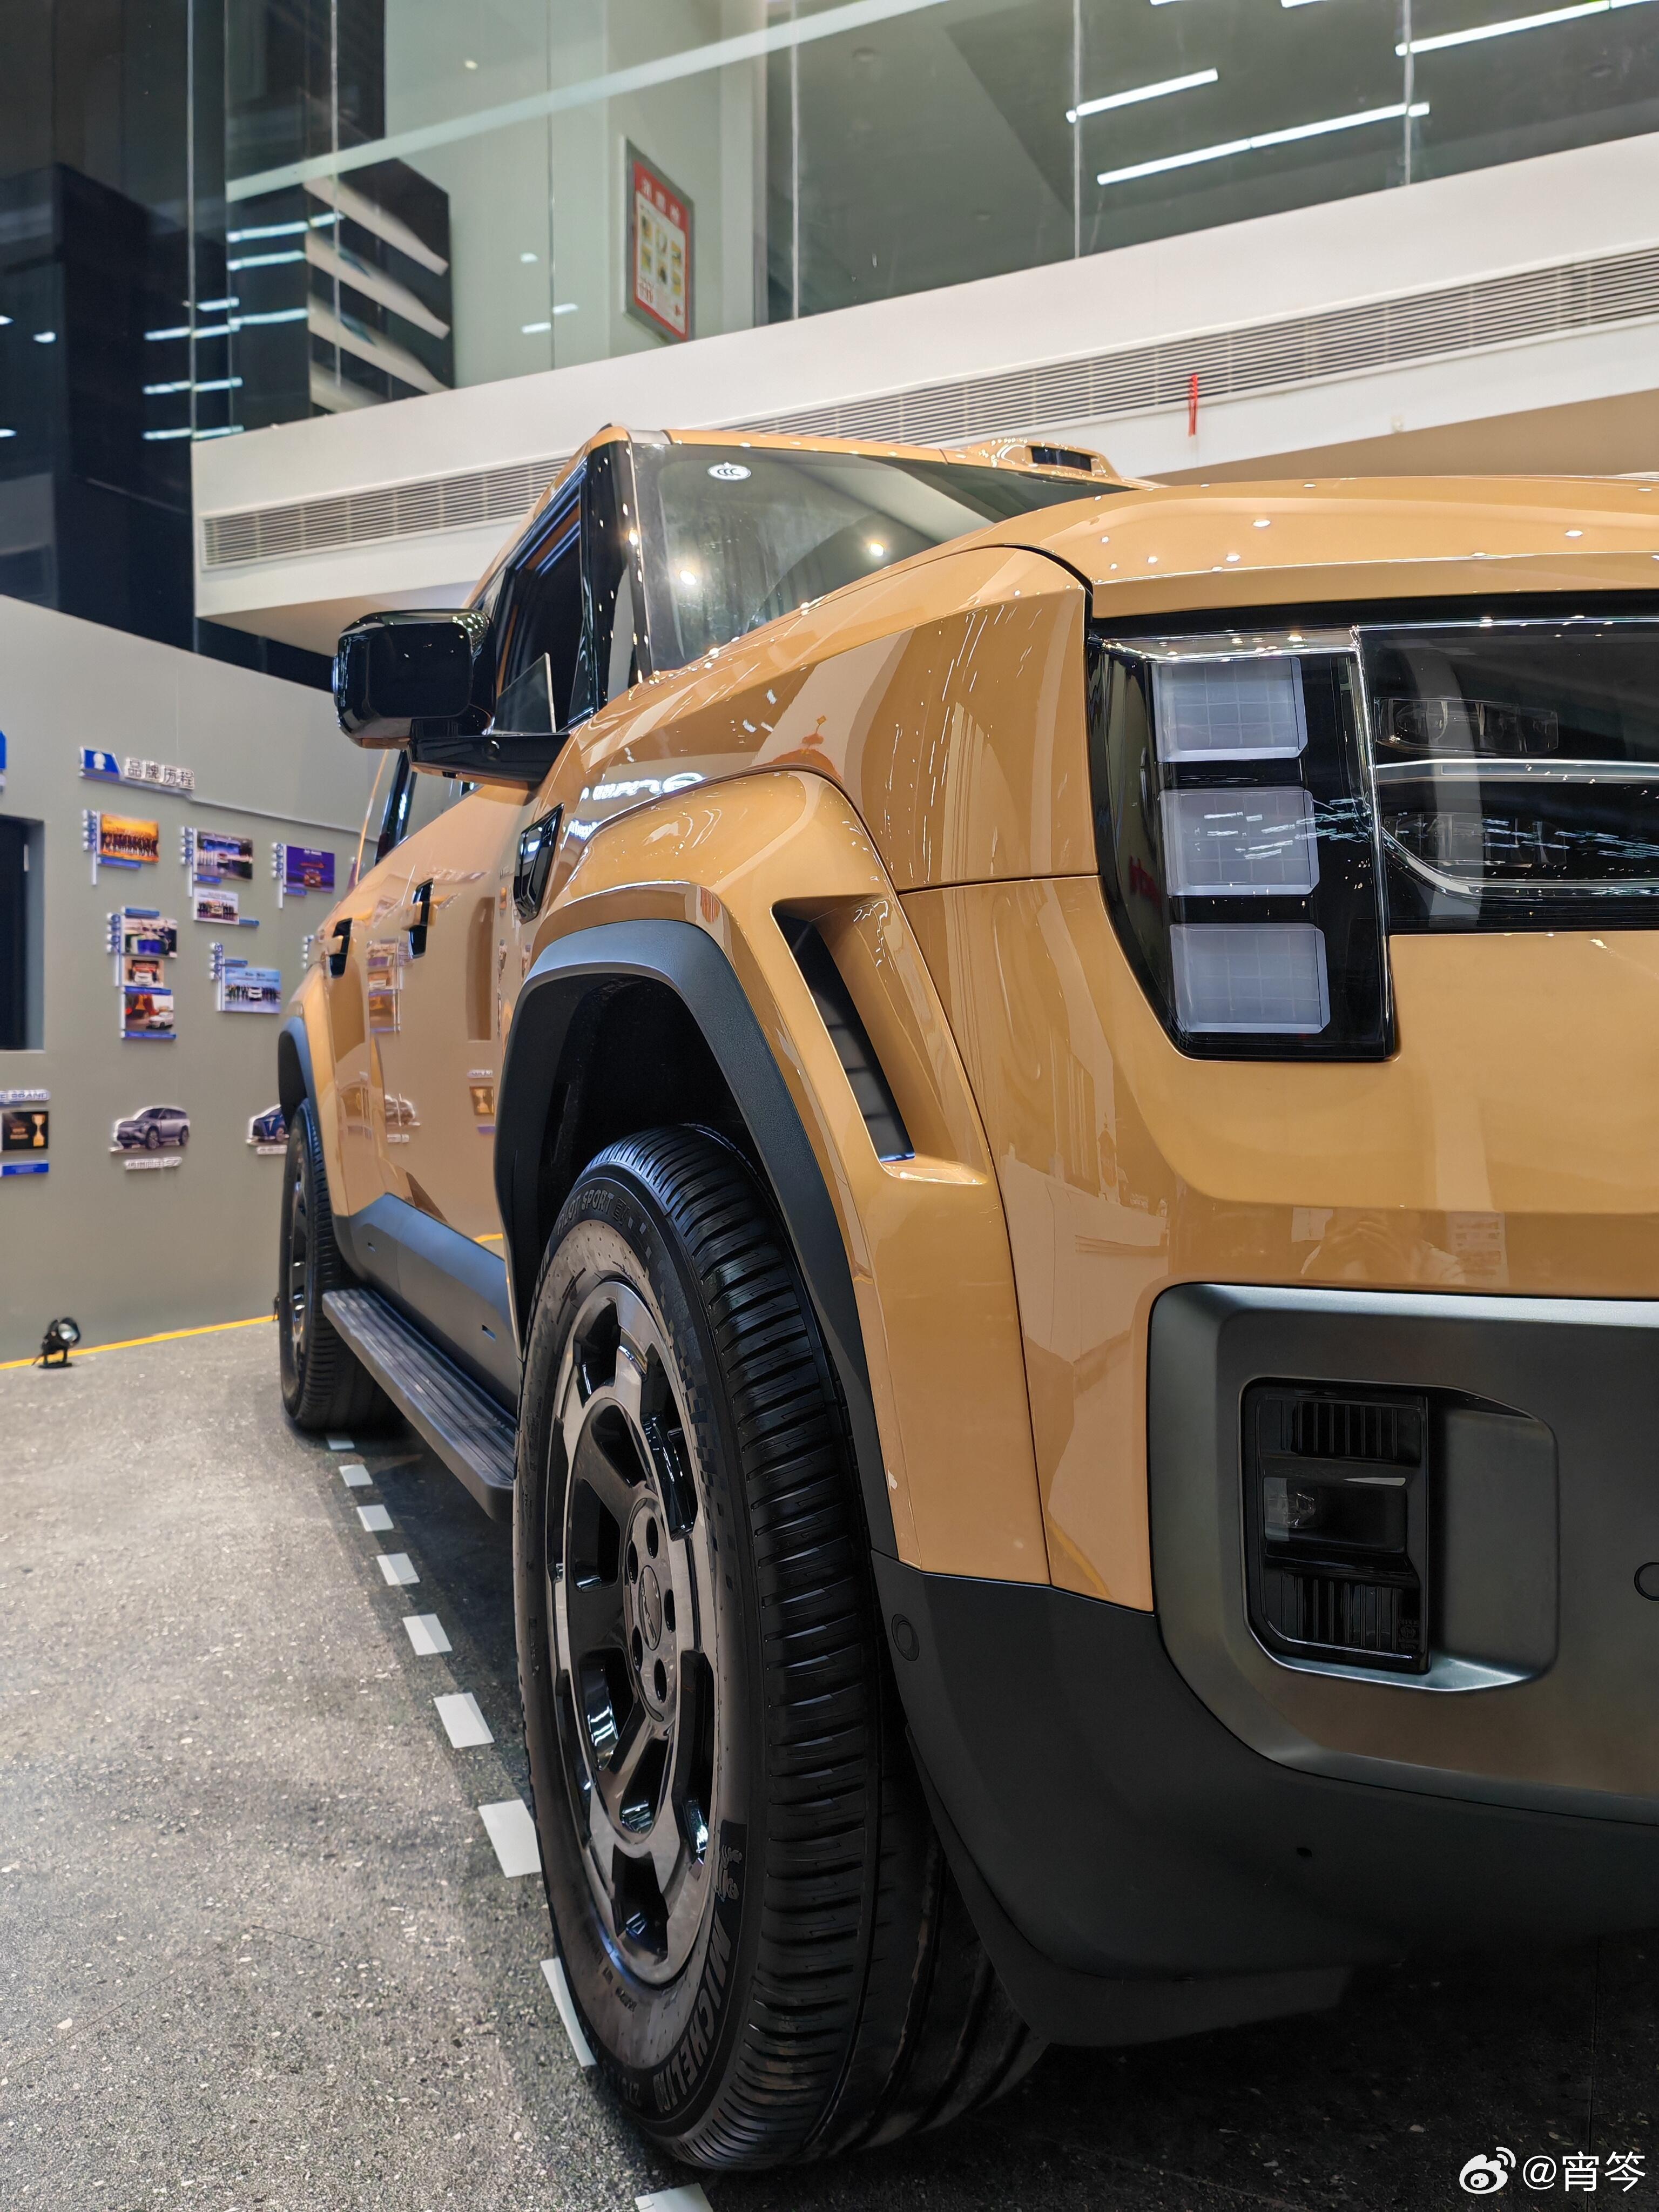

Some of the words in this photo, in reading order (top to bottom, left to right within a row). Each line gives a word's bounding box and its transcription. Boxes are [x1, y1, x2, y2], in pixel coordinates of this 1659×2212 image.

[125, 757, 194, 790] 品牌历程
[581, 1189, 615, 1215] SPORT
[653, 1910, 731, 2113] MICHELIN
